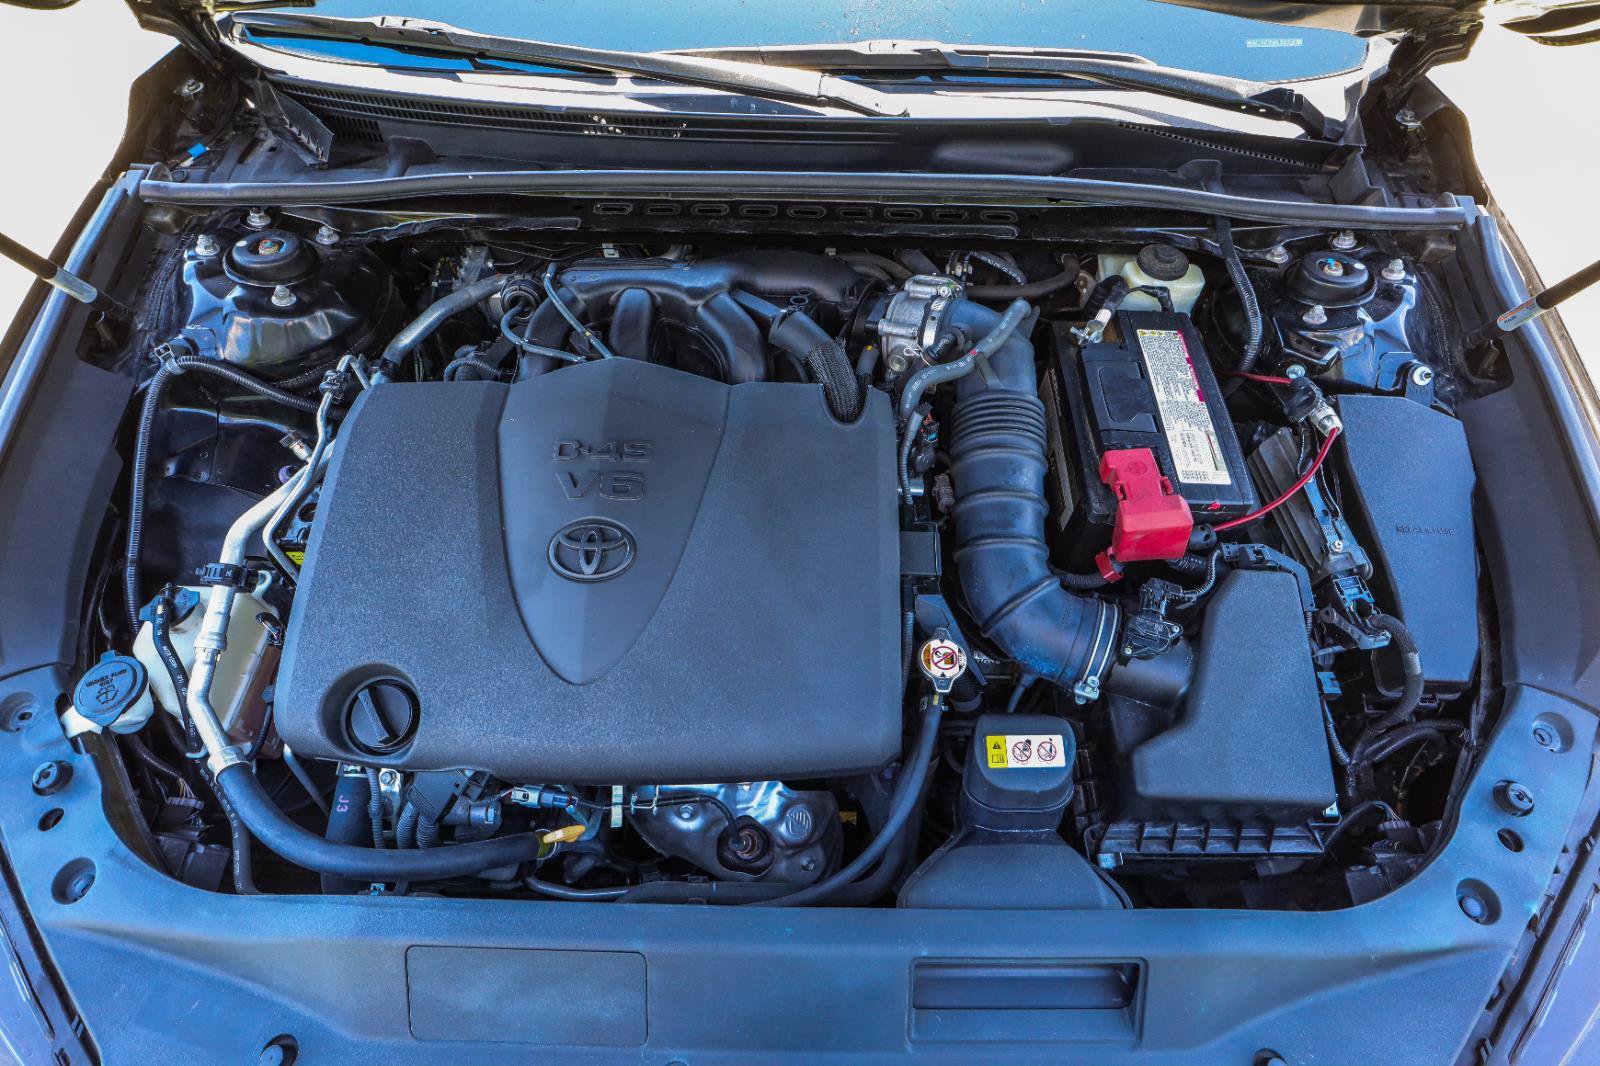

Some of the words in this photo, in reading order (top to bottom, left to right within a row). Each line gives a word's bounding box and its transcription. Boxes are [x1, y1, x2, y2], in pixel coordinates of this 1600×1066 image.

[552, 439, 653, 462] D-4S
[555, 471, 645, 501] V6
[336, 794, 350, 813] J3
